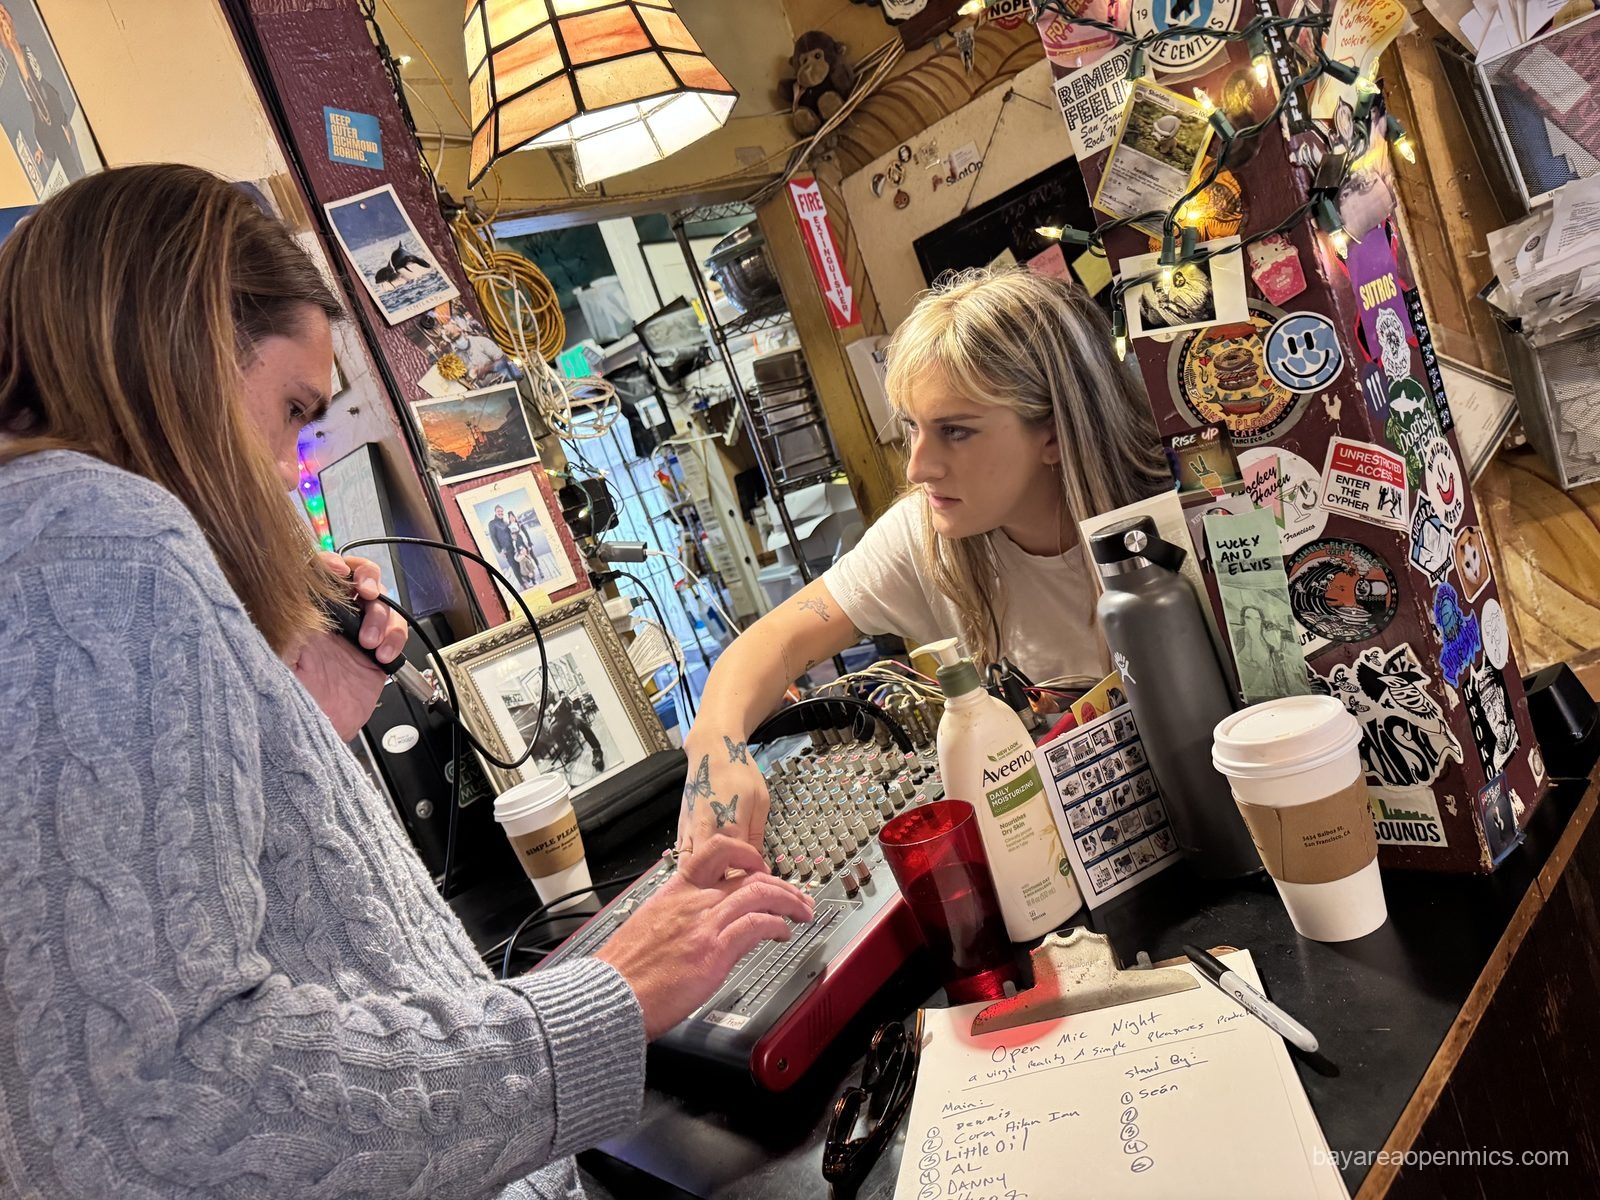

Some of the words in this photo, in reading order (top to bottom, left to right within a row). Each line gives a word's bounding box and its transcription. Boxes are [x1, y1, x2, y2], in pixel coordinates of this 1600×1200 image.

[1137, 9, 1148, 20] 19
[329, 112, 352, 126] KEEP
[330, 124, 358, 140] OUTER
[1080, 124, 1099, 139] San
[332, 134, 379, 154] RICHMOND
[1083, 132, 1106, 151] Rock
[333, 145, 369, 162] BORING.
[797, 189, 824, 213] FIRE
[812, 215, 849, 313] EXTINGUISHER
[1359, 272, 1398, 312] SUTROS
[1171, 433, 1197, 449] RISE
[1201, 427, 1220, 441] UP
[1339, 447, 1402, 475] UNRESTRICTED
[1355, 463, 1394, 482] ACCESS
[1250, 473, 1291, 505] Haven
[1335, 474, 1371, 491] ENTER
[1340, 485, 1361, 499] THE
[1327, 493, 1370, 512] CYPHER
[1283, 524, 1316, 542] Francisco
[1220, 548, 1253, 564] AND
[1227, 558, 1272, 576] ELVIS
[982, 750, 1032, 788] Aveeno
[989, 786, 1010, 801] DAILY
[991, 779, 1035, 808] MOISTURIZING
[525, 838, 556, 857] SIMPLE
[991, 1045, 1041, 1063] Open
[1057, 1031, 1088, 1048] Mic
[1111, 1011, 1163, 1036] Night
[1147, 1022, 1204, 1043] Pleasures
[941, 1100, 984, 1113] Main:
[956, 1108, 1011, 1130] Dennis
[945, 1141, 989, 1161] Little
[951, 1162, 982, 1175] AL
[948, 1173, 1008, 1195] DANNY
